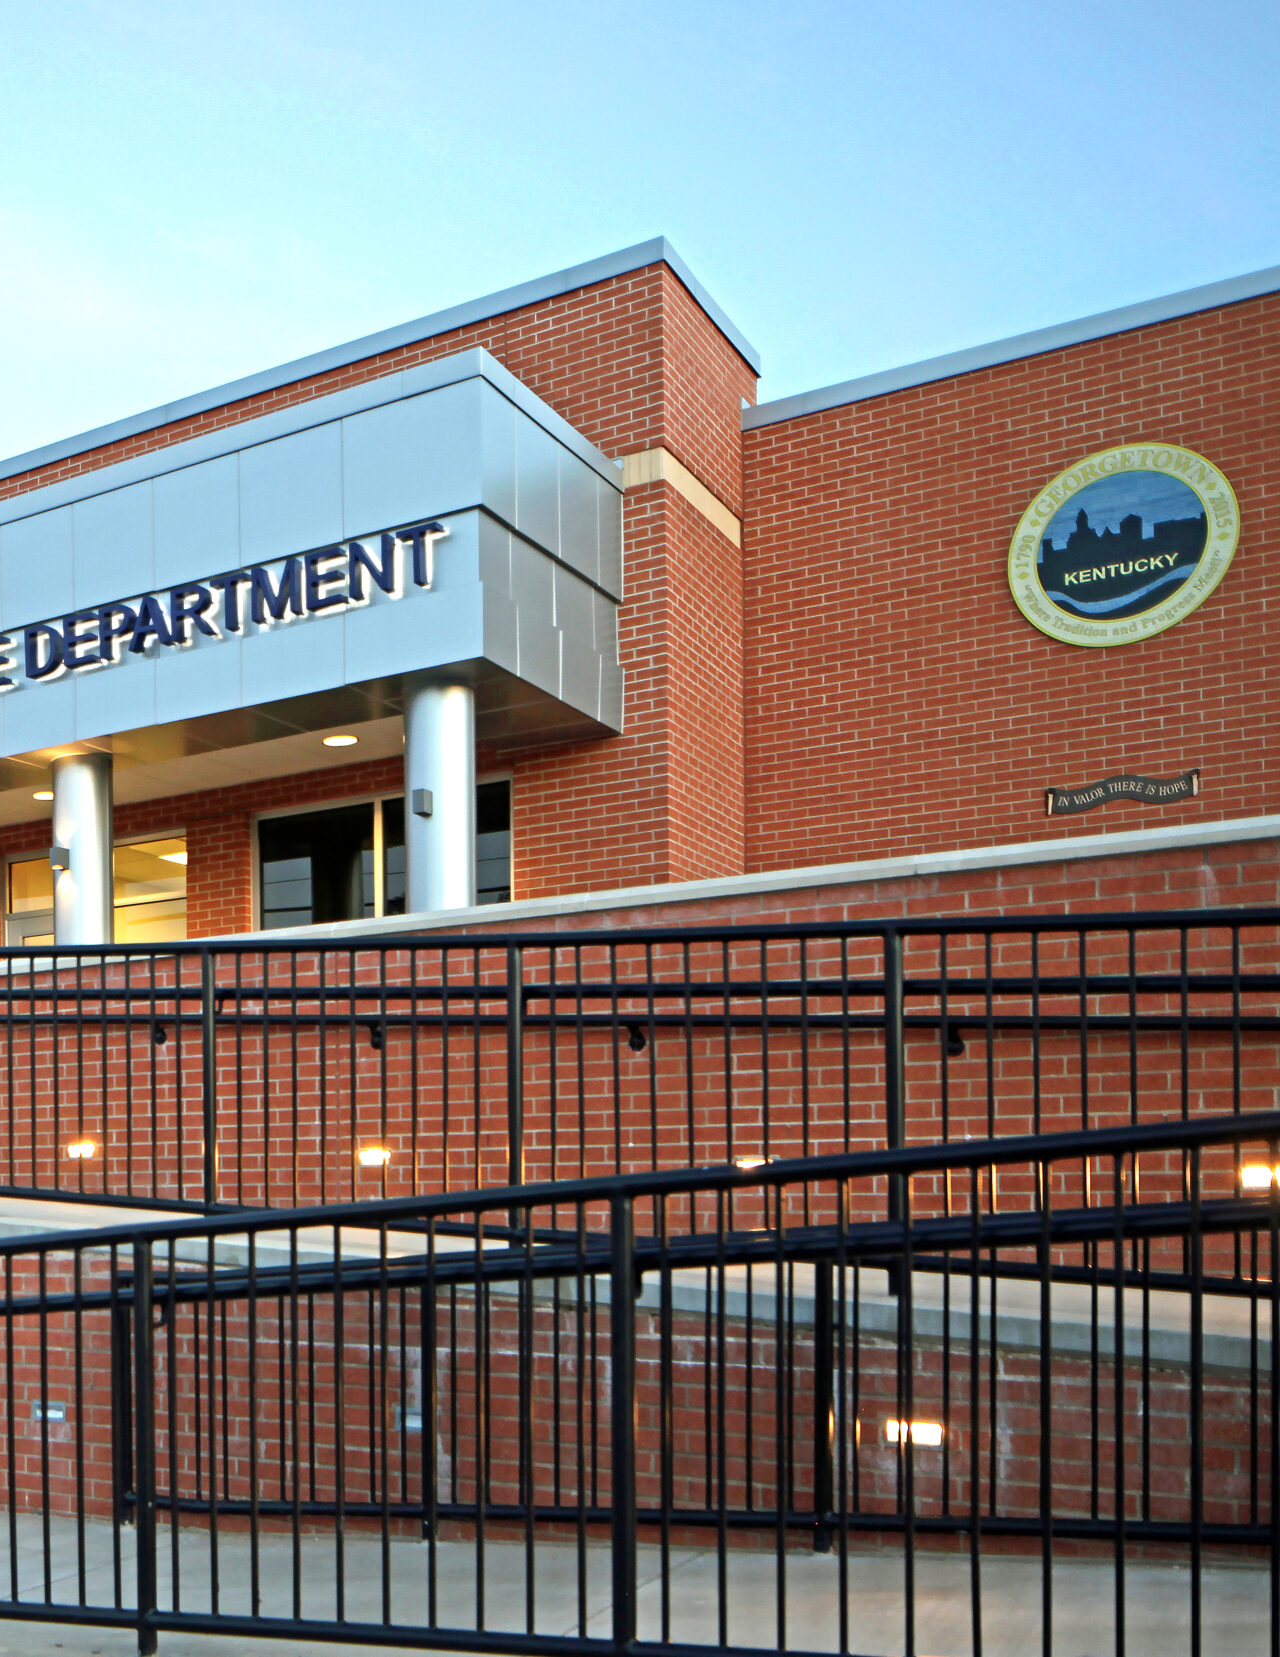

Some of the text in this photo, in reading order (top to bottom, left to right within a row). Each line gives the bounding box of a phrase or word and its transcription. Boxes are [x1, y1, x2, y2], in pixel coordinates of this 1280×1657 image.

[1034, 450, 1214, 518] GEORGETOWN
[1208, 491, 1234, 529] 2015
[1015, 534, 1036, 570] 1790
[1064, 552, 1179, 586] KENTUCKY
[25, 521, 445, 681] DEPARTMENT
[1052, 616, 1108, 637] Tradition
[1112, 621, 1137, 637] and
[1140, 593, 1196, 629] Progress
[1057, 780, 1188, 807] IN VALOR THERE IS HOPE
